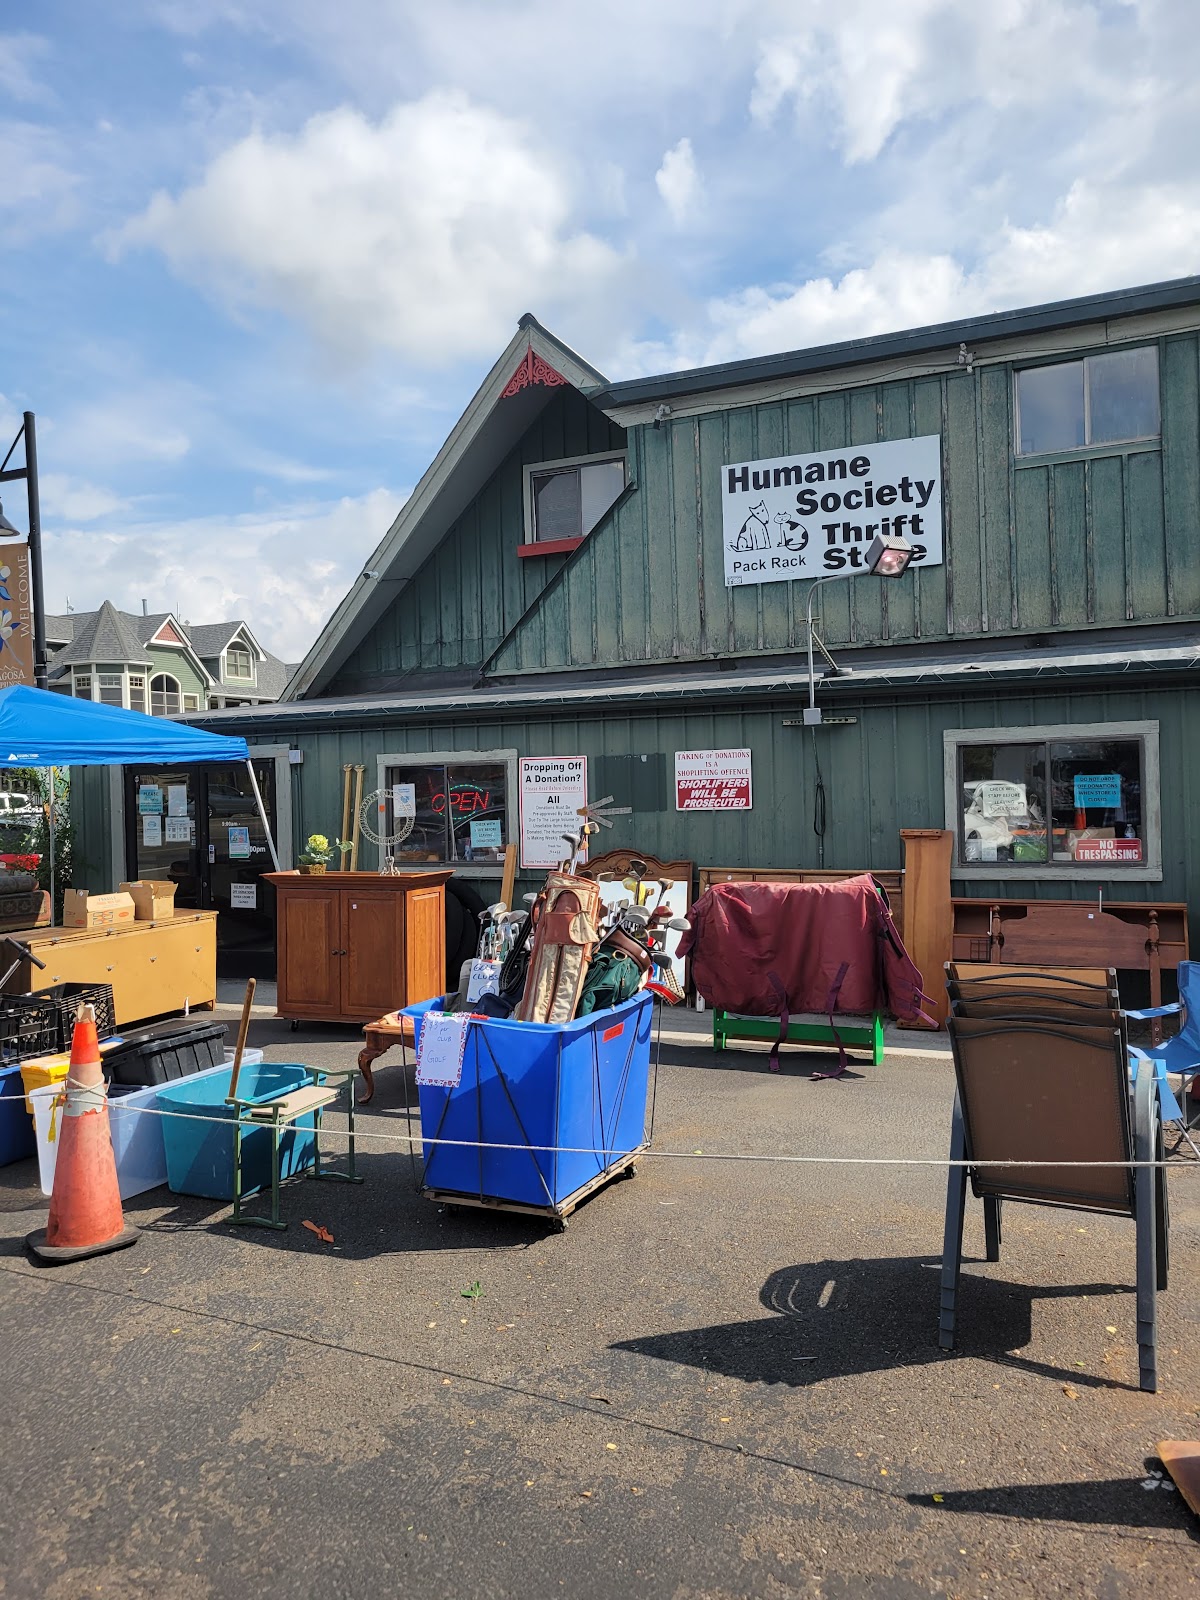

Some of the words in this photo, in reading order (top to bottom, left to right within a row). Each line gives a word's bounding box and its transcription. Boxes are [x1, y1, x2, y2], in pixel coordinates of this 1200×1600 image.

[728, 456, 870, 493] Humane
[795, 476, 935, 515] Society
[822, 514, 924, 545] Thrift
[823, 544, 927, 570] Ste
[733, 559, 767, 573] Pack
[771, 554, 807, 569] Rack
[17, 554, 31, 638] WELCOME
[715, 751, 750, 759] DONATIONS
[524, 763, 565, 773] Dropping
[568, 761, 582, 771] Off
[525, 775, 532, 783] A
[535, 773, 581, 783] Donation?
[679, 779, 748, 789] SHOPLIFTERS
[690, 789, 717, 798] WILL
[721, 788, 738, 797] BE
[431, 791, 489, 812] OPEN
[547, 795, 560, 804] All
[683, 797, 746, 807] PROSECUTED
[1099, 840, 1114, 849] NO
[1079, 849, 1138, 860] TRESPASSING
[439, 1027, 451, 1035] per
[427, 1050, 447, 1063] GOLF
